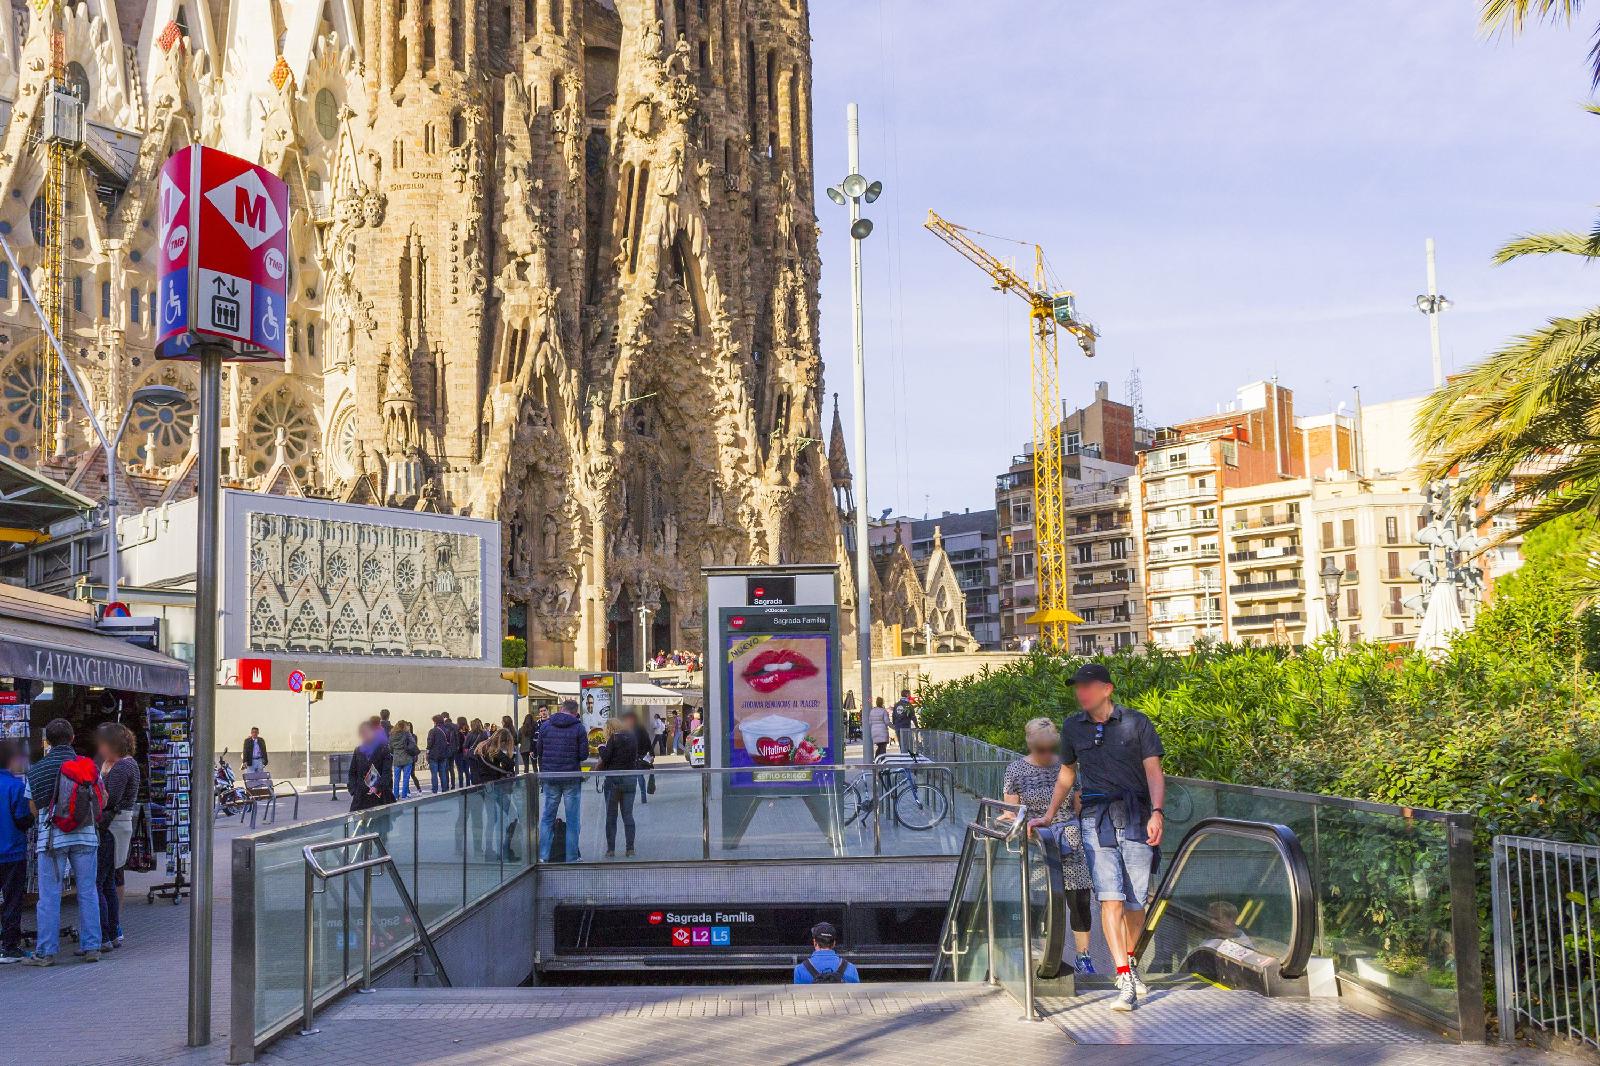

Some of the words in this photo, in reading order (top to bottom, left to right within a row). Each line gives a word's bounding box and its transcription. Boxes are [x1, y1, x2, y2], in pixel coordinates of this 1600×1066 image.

[234, 185, 267, 233] M
[171, 236, 185, 249] TMB
[268, 257, 283, 272] TMB
[754, 598, 783, 606] Sagrada
[773, 617, 801, 625] Sagrada
[730, 637, 759, 658] NUEVO
[55, 653, 144, 690] VANGUARDIA
[666, 913, 711, 924] Sagrada
[715, 912, 755, 923] Família
[692, 930, 708, 941] L2
[713, 930, 728, 941] L5
